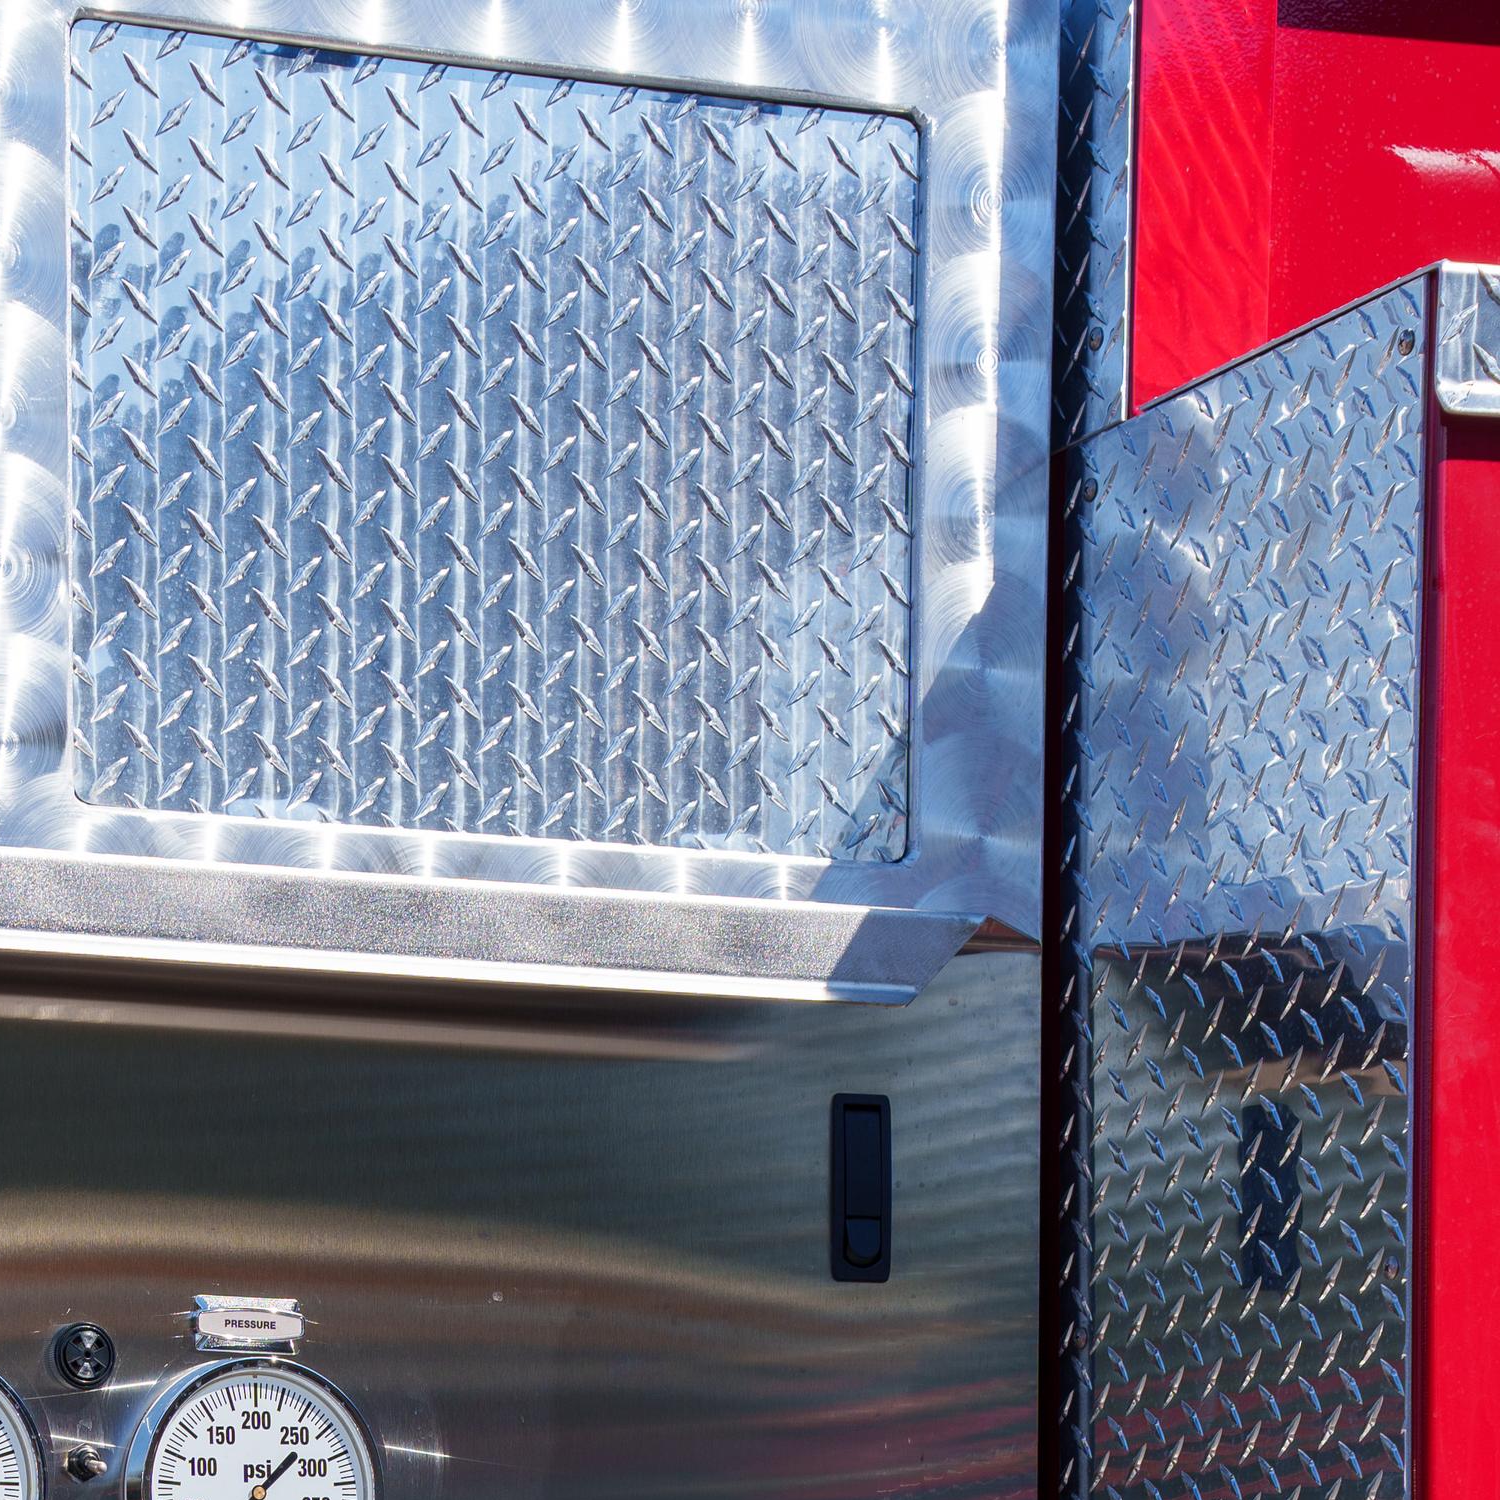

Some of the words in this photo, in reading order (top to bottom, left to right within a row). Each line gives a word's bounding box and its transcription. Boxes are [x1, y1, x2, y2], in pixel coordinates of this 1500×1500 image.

[224, 1320, 276, 1329] PRESSURE
[242, 1411, 271, 1430] 200
[207, 1426, 236, 1445] 150
[280, 1427, 309, 1445] 250
[189, 1458, 218, 1476] 100
[244, 1460, 272, 1483] psi
[298, 1459, 327, 1477] 300
